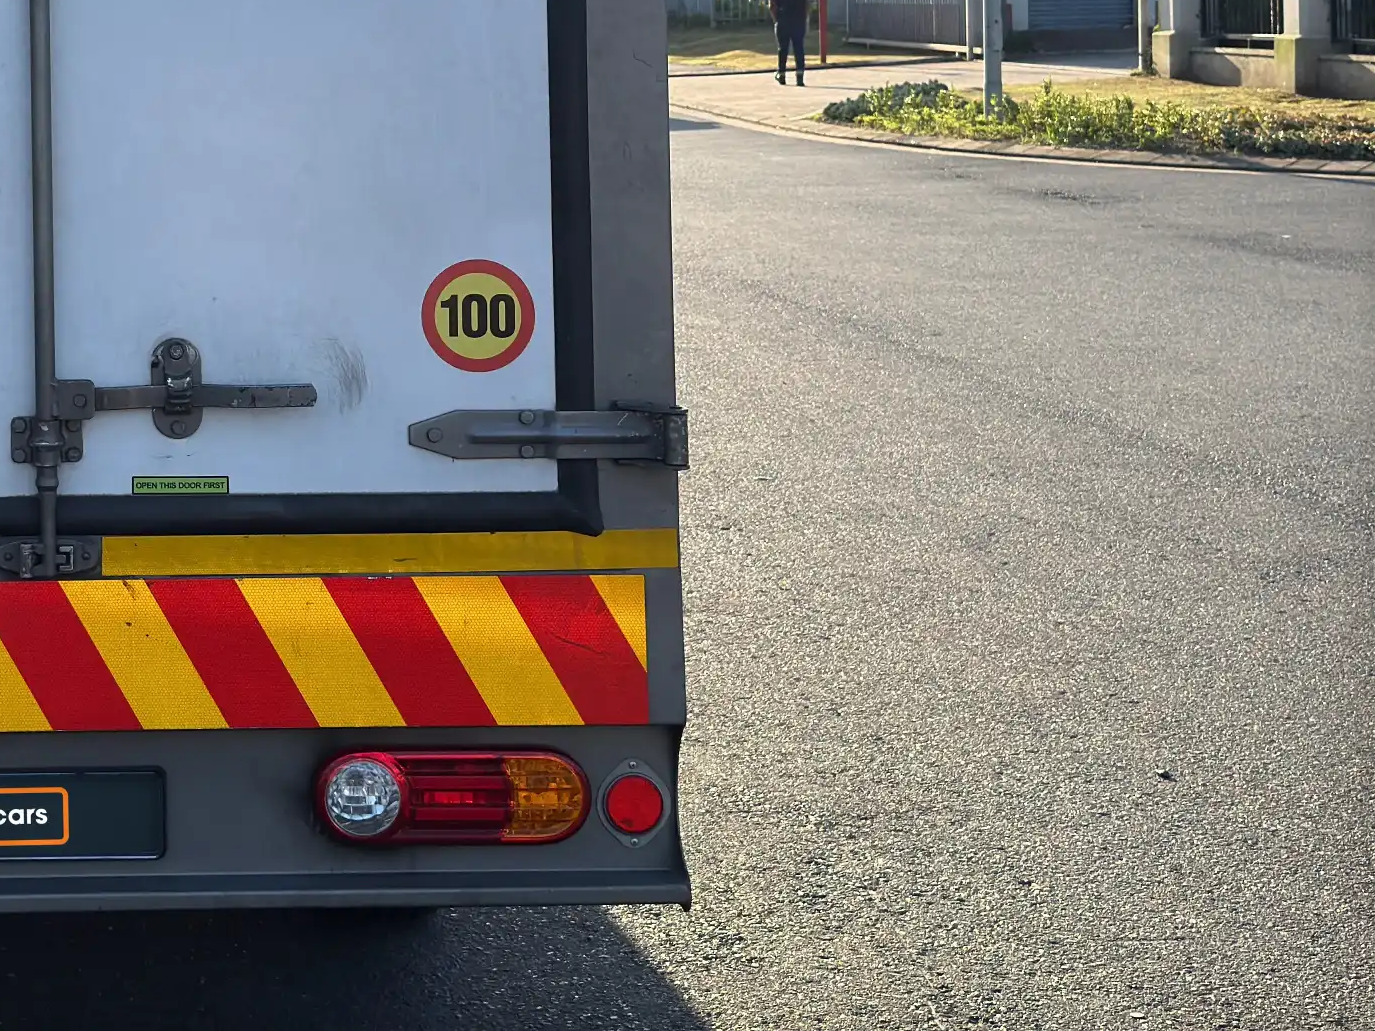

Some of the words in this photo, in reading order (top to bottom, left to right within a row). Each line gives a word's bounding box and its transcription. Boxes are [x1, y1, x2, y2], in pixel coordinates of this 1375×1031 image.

[440, 293, 516, 339] 100
[178, 481, 202, 489] DOOR
[203, 481, 226, 489] FIRST
